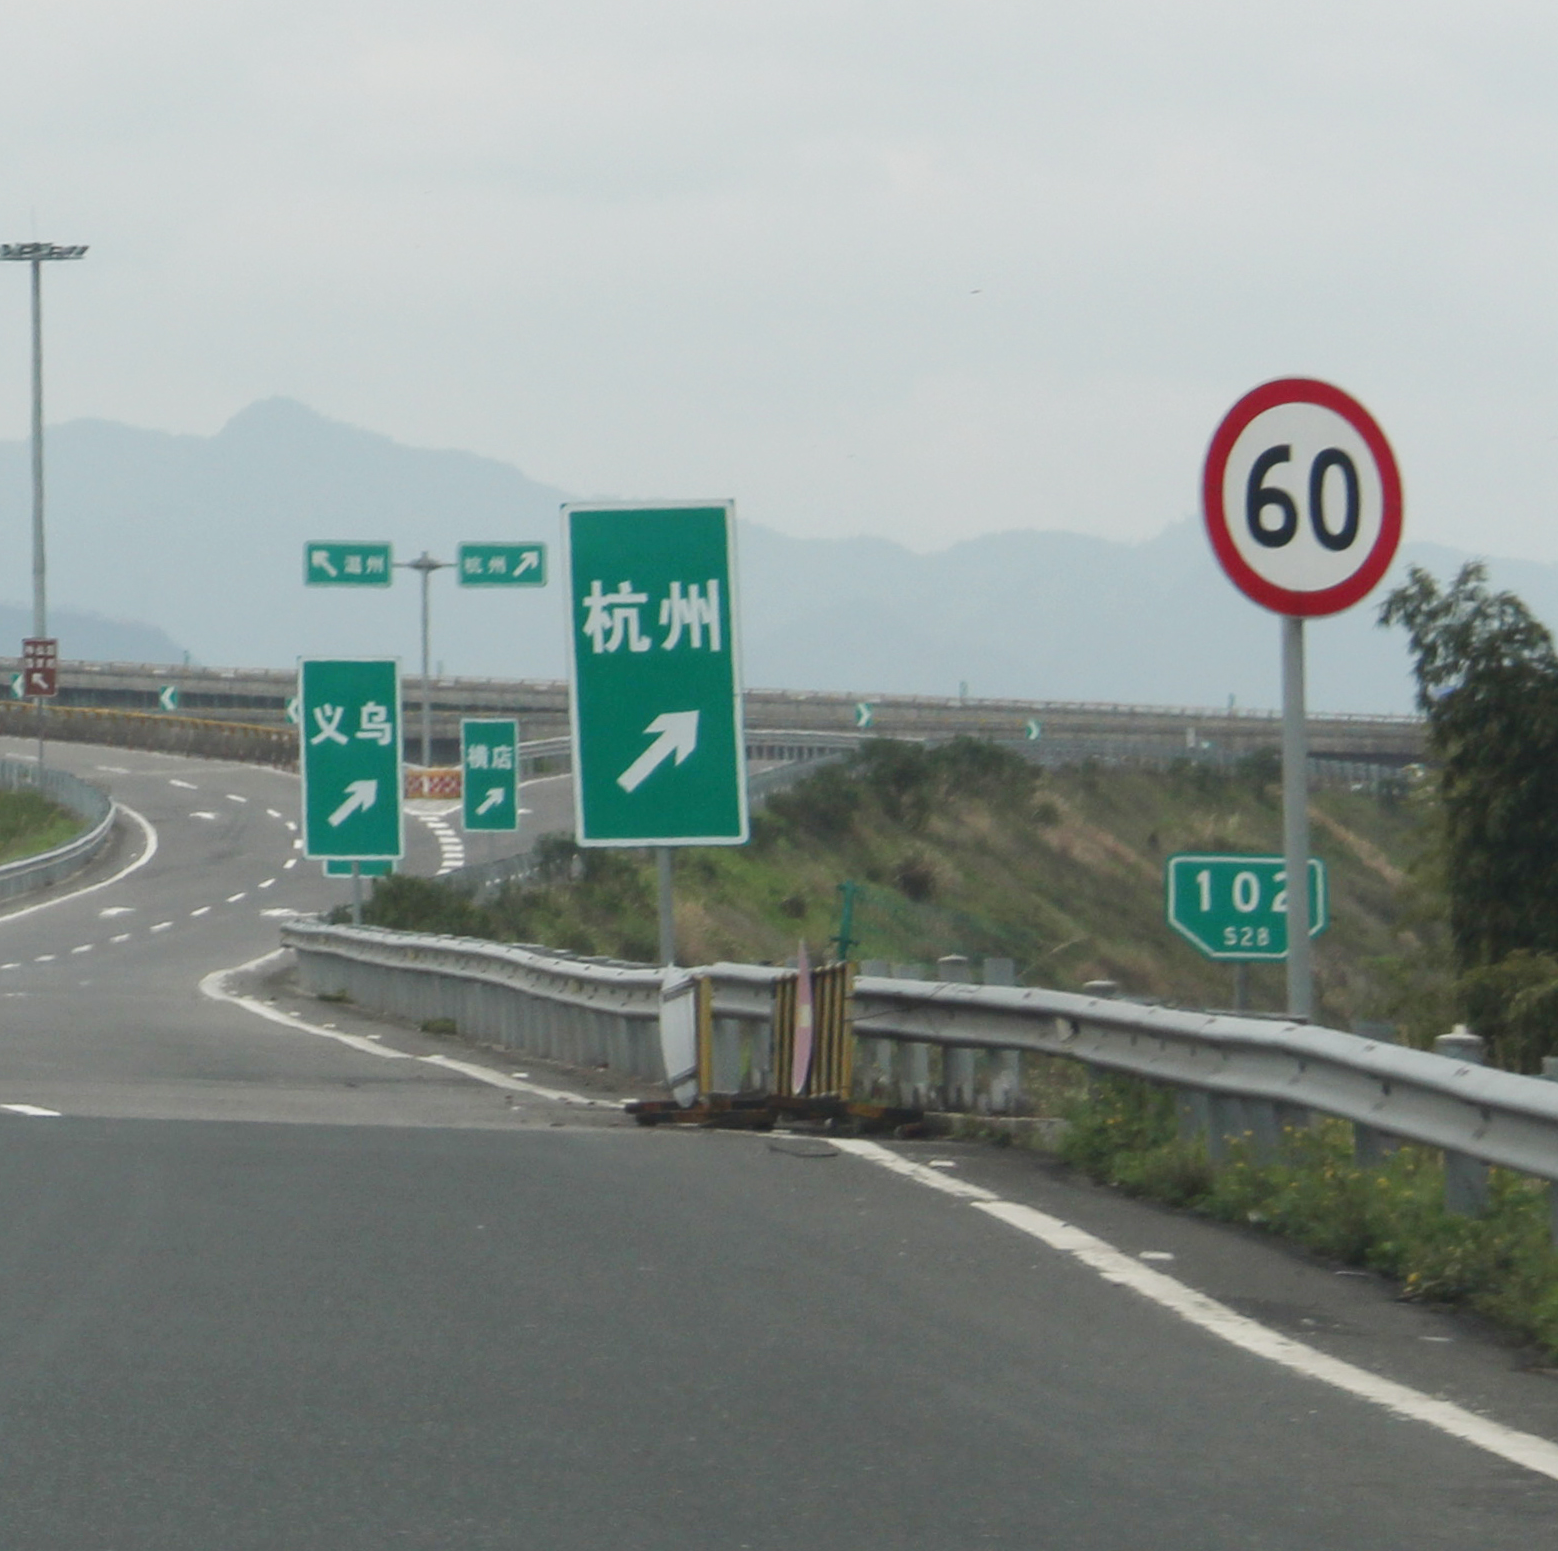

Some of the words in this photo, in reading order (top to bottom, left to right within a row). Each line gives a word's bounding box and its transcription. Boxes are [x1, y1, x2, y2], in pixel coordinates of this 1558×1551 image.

[1245, 444, 1361, 552] 60
[582, 578, 722, 654] 杭州
[310, 701, 394, 746] 义乌
[1223, 926, 1271, 947] S28
